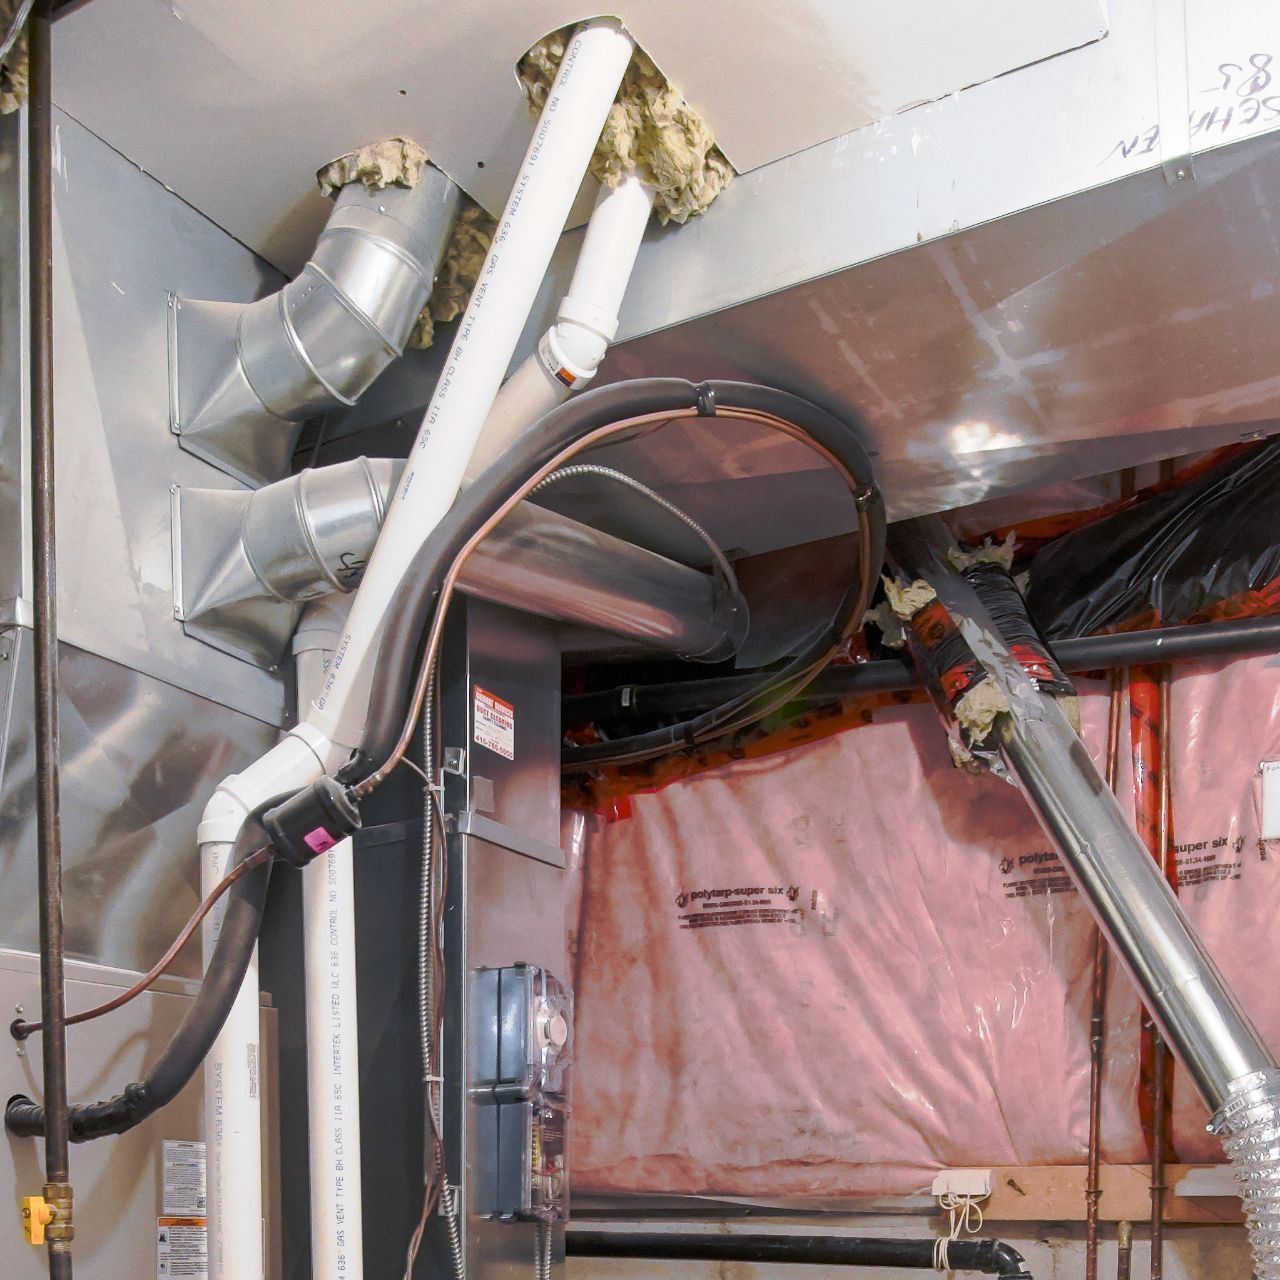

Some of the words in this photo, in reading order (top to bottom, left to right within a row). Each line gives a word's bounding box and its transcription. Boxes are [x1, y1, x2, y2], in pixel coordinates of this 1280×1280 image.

[560, 40, 581, 88] CONTROL
[550, 97, 559, 112] NO
[509, 175, 529, 216] SYSTEM
[487, 255, 498, 274] GAS
[474, 283, 488, 309] VENT
[461, 316, 475, 341] TYPE
[439, 366, 455, 398] CLASS
[336, 632, 351, 669] SYSTEM
[1211, 837, 1228, 848] six
[330, 909, 338, 945] CONTROL
[331, 995, 341, 1028] LISTED
[333, 1034, 341, 1075] INTERTEK
[335, 1127, 343, 1154] CLASS
[336, 1161, 343, 1171] BH
[336, 1176, 344, 1197] TYPE
[337, 1204, 345, 1224] VENT
[337, 1230, 345, 1246] GAS
